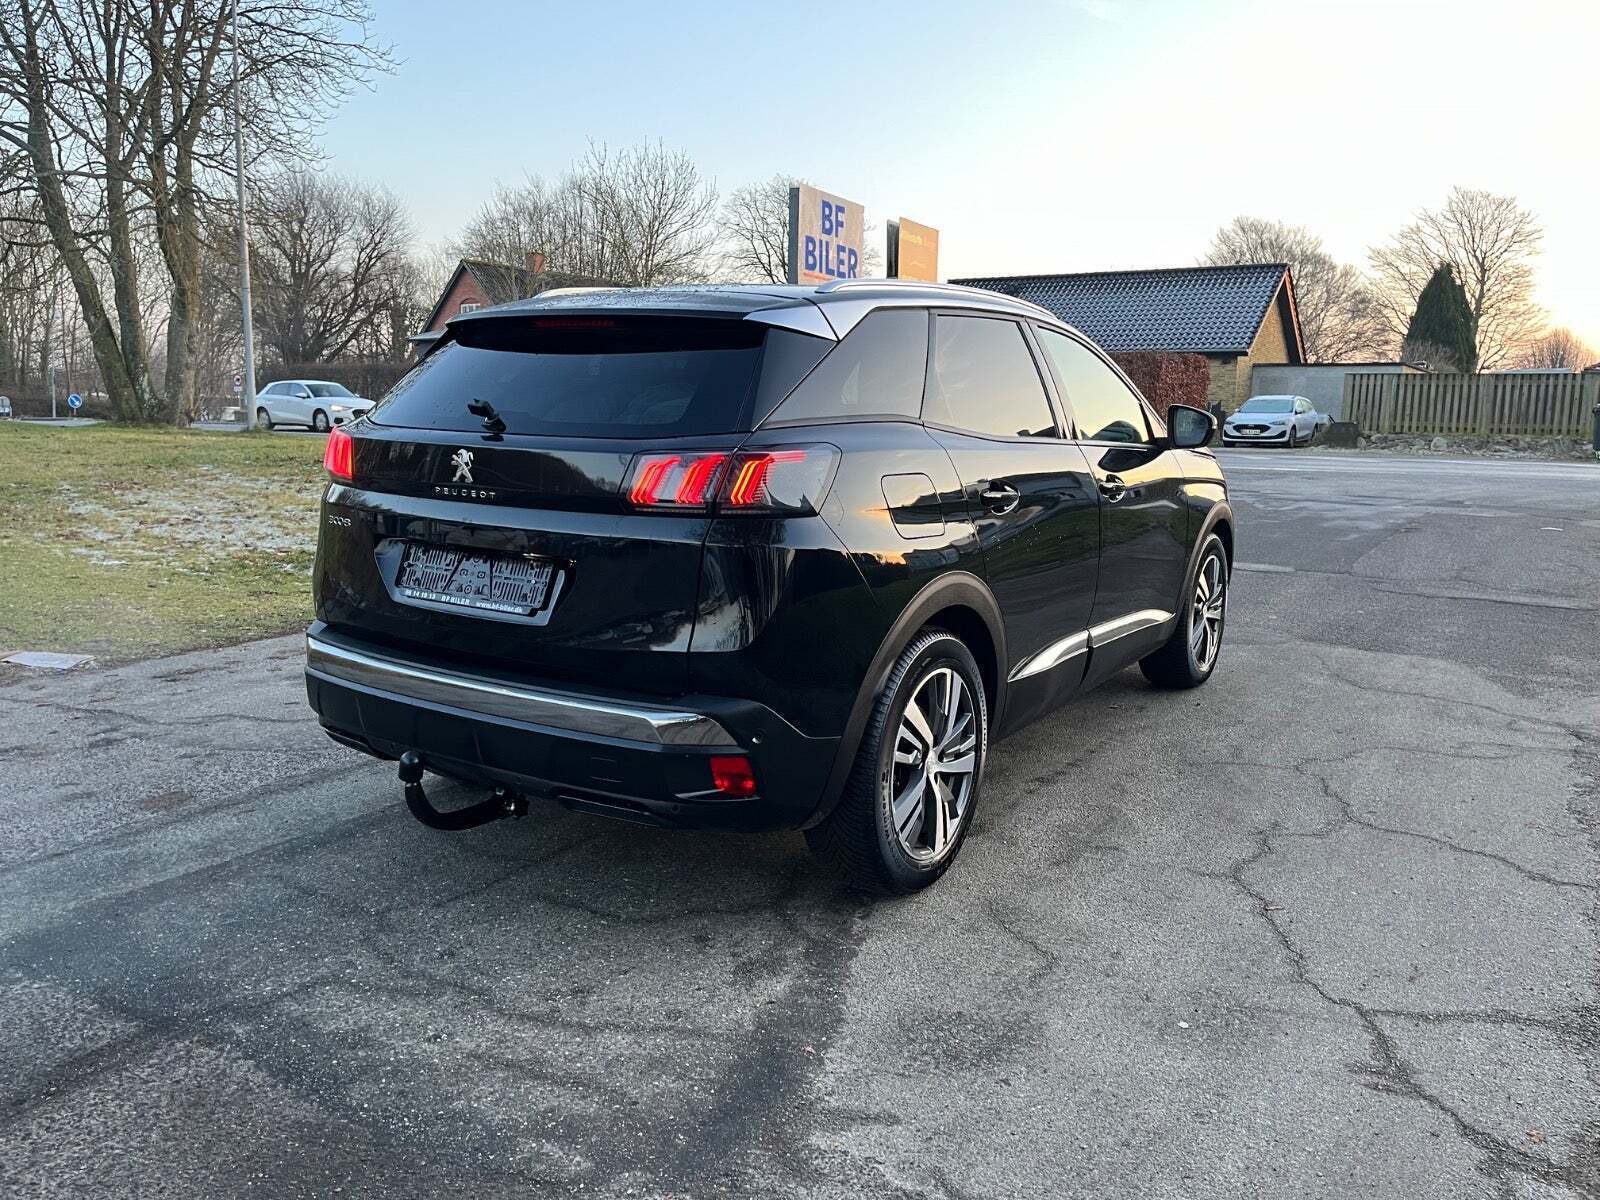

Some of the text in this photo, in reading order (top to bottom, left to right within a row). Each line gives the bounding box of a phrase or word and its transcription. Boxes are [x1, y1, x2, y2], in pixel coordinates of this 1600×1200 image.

[820, 200, 846, 238] BF
[804, 235, 859, 280] BILER
[434, 486, 496, 500] PEUGEOT
